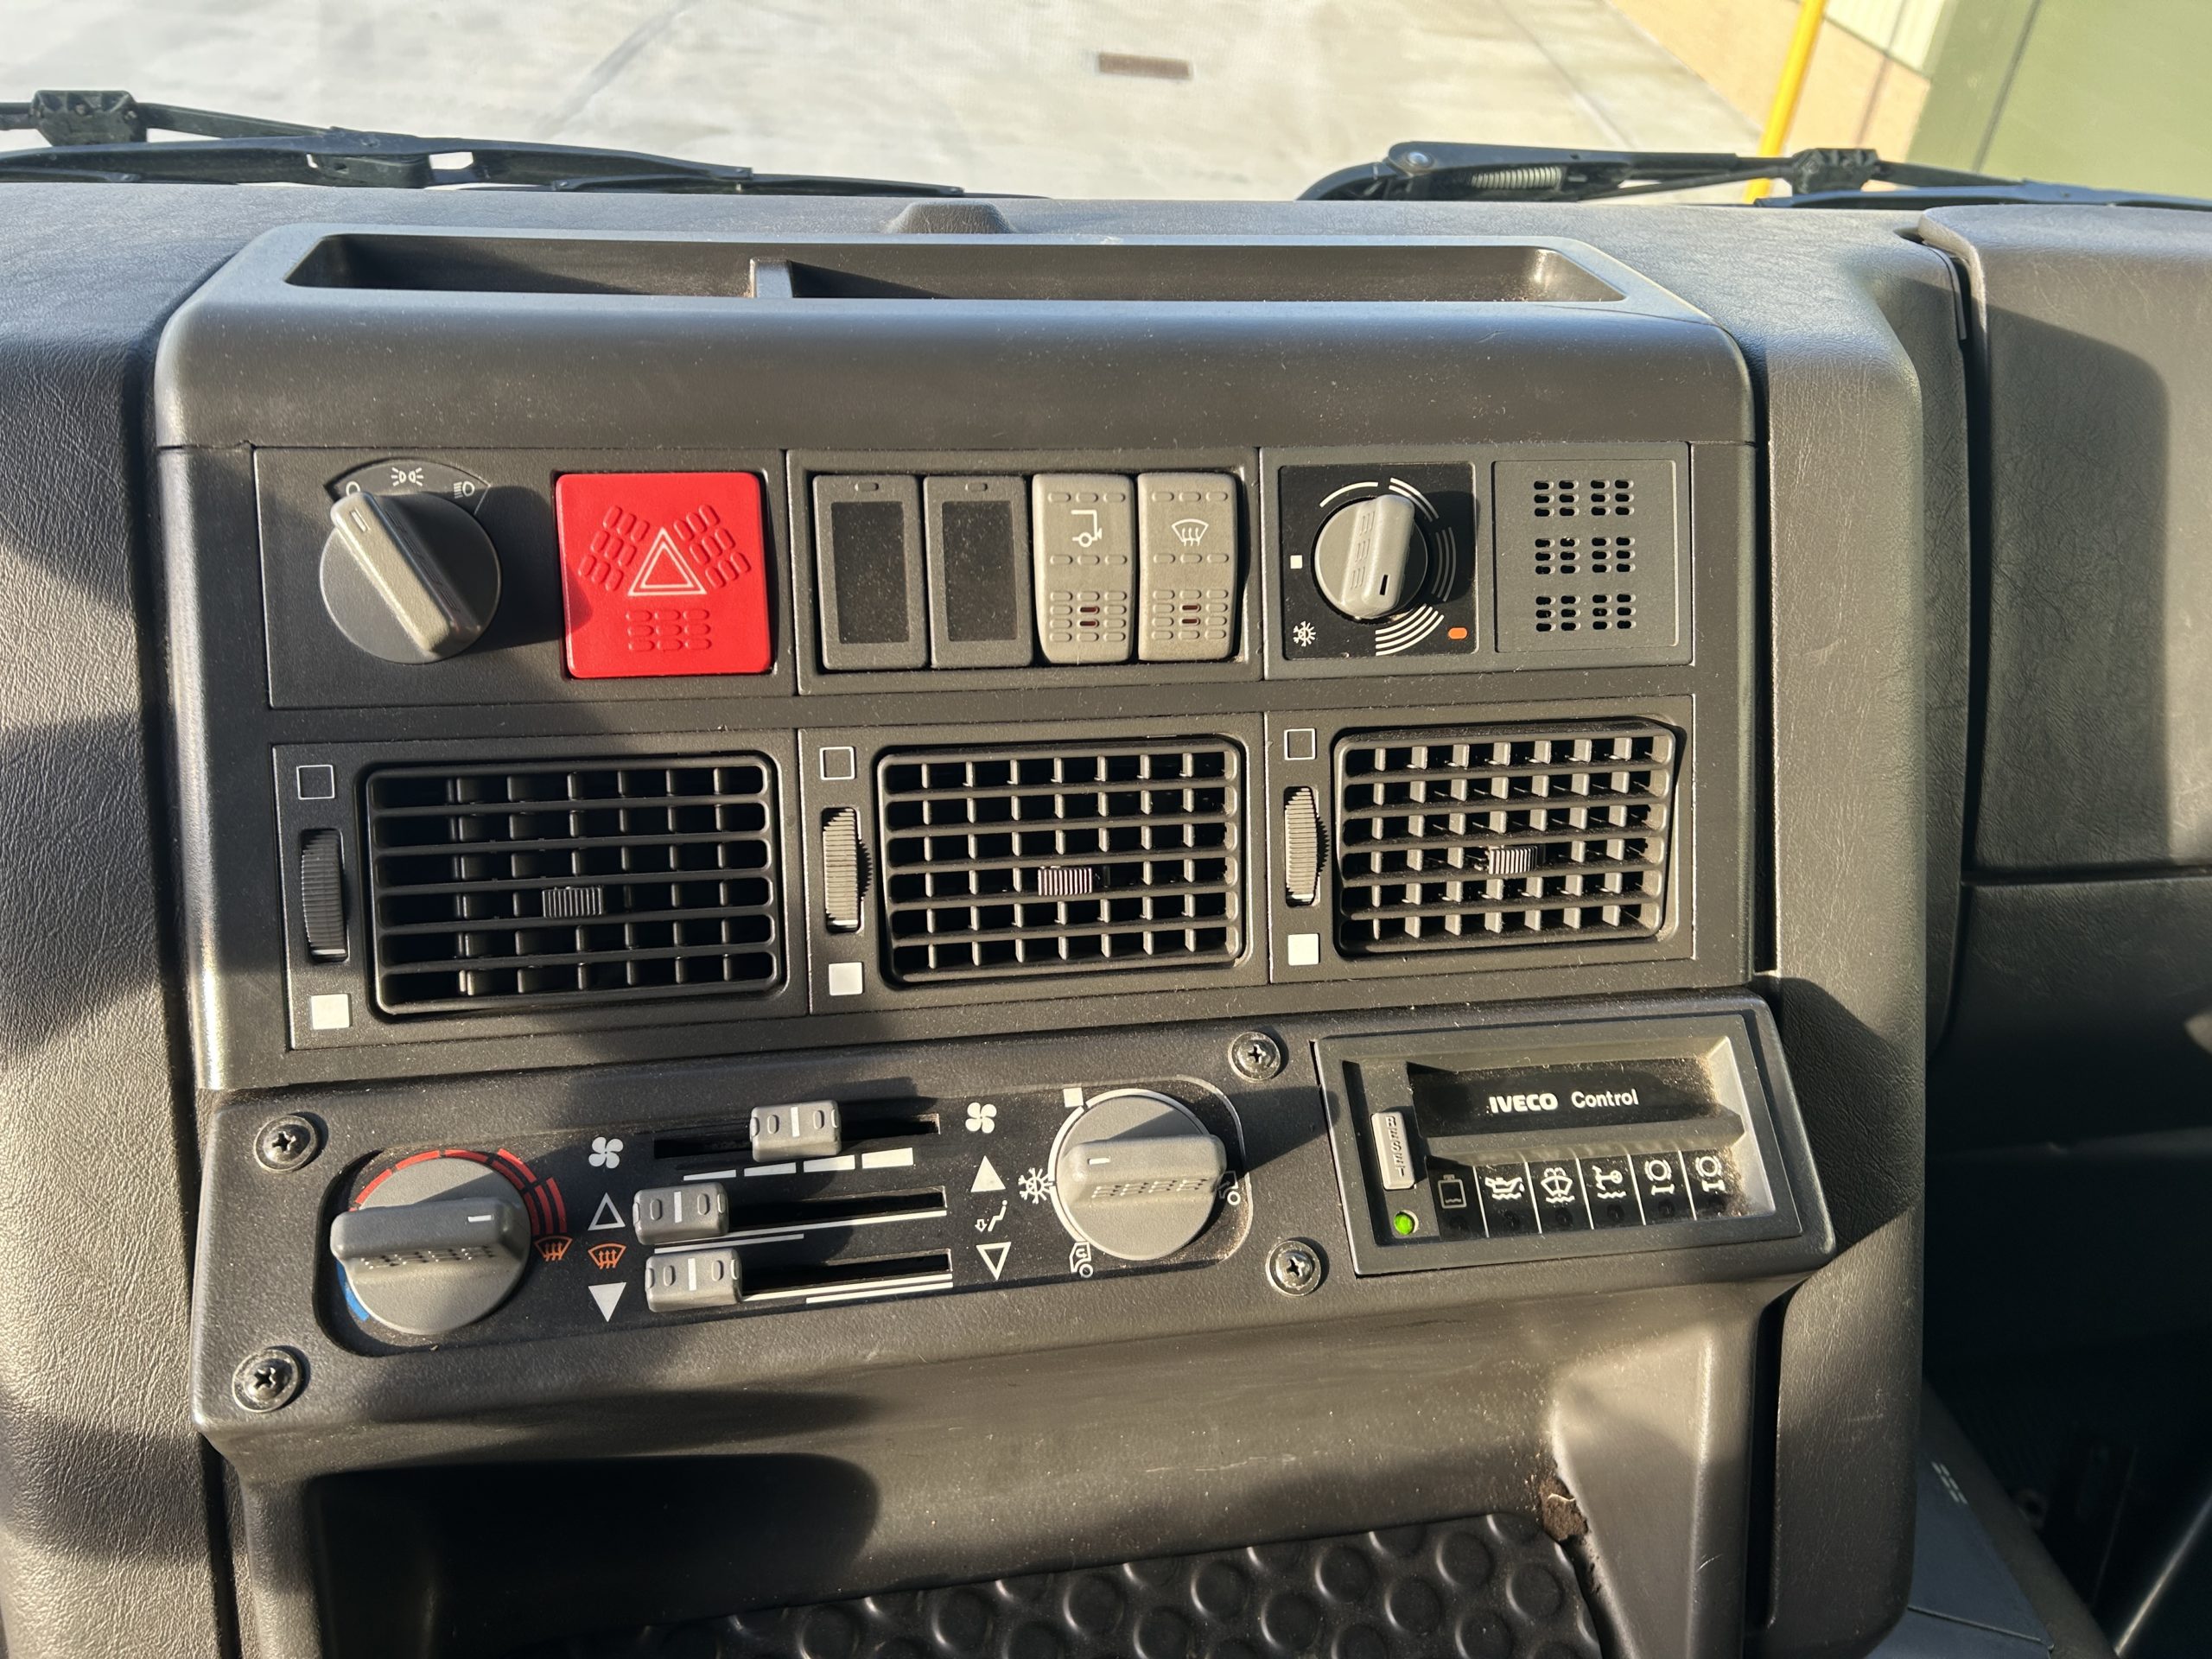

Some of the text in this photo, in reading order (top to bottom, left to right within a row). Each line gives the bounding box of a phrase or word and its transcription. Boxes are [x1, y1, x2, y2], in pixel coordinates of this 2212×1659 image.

[1489, 1088, 1639, 1114] IVECO Control
[1385, 1116, 1406, 1177] RESET
